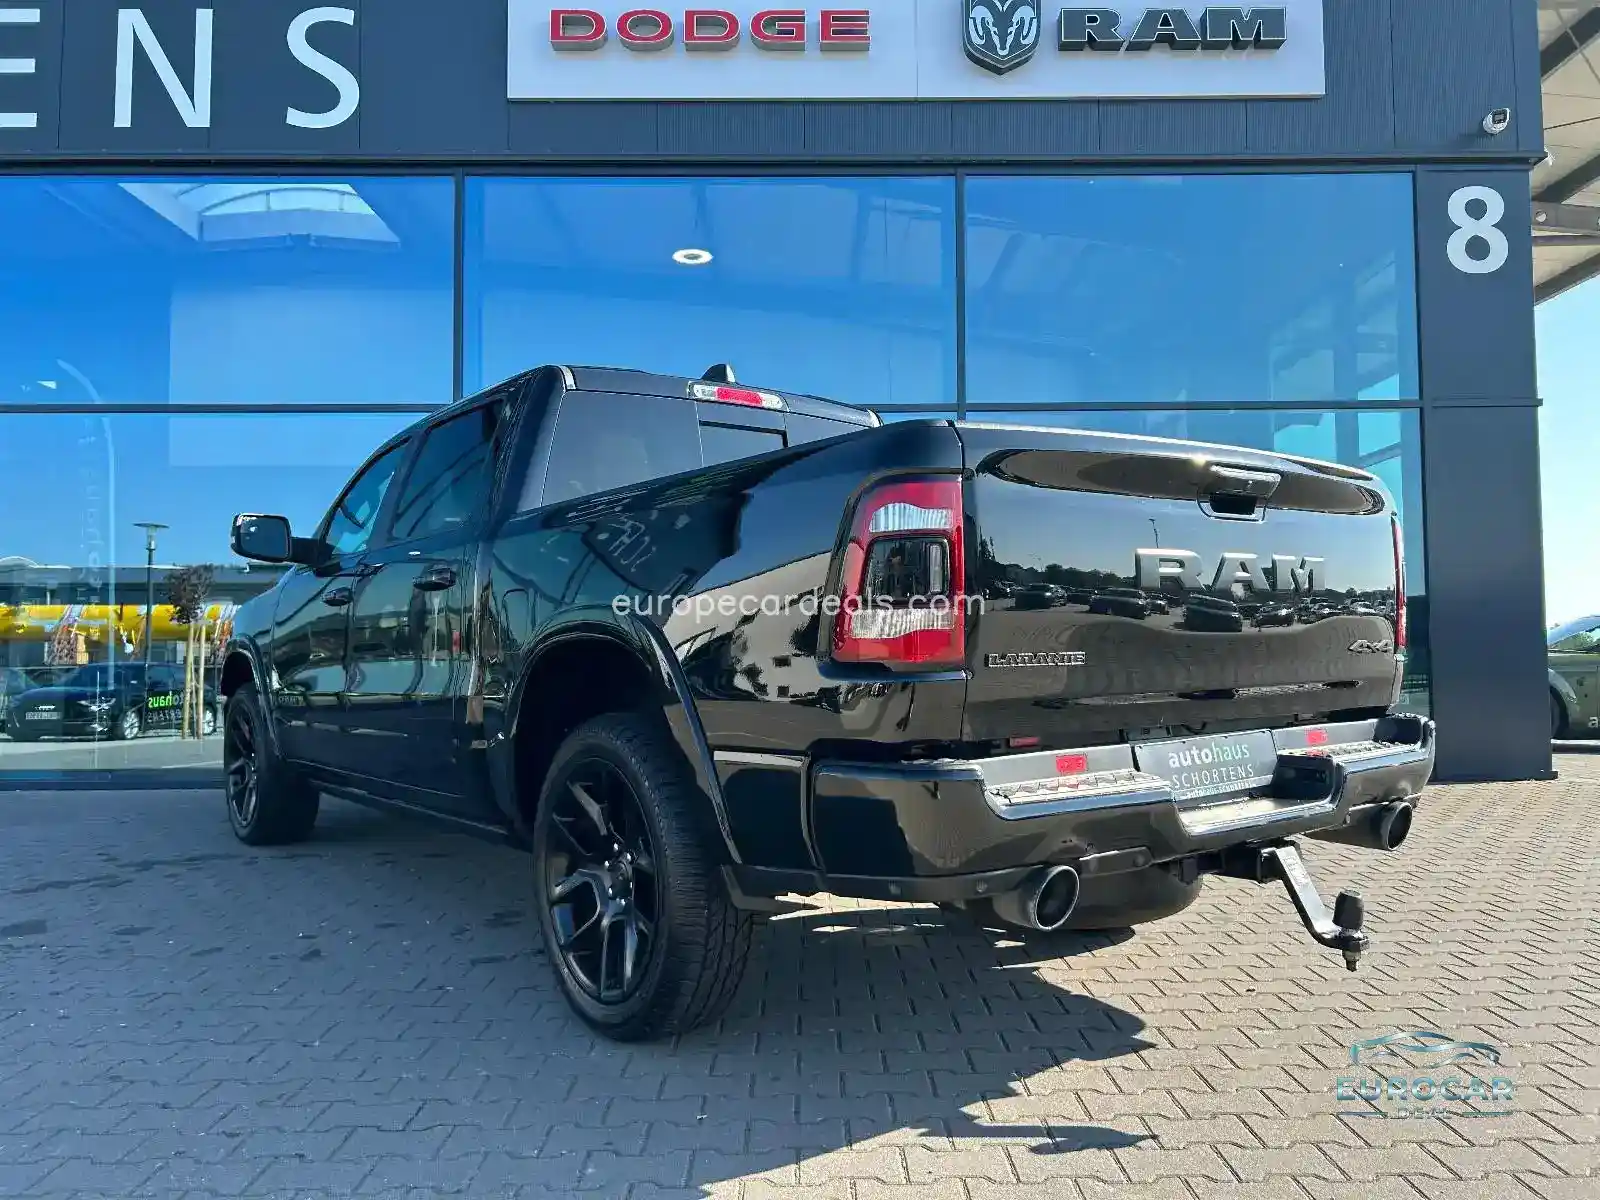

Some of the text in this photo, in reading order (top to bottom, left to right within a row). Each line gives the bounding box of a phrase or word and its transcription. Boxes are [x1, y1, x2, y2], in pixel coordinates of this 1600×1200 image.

[549, 9, 872, 51] DODGE
[1058, 7, 1287, 51] RAM
[1446, 185, 1509, 274] 8
[1134, 547, 1326, 595] RAM
[1168, 741, 1250, 769] autohaus
[1172, 763, 1254, 790] SCHORTENS
